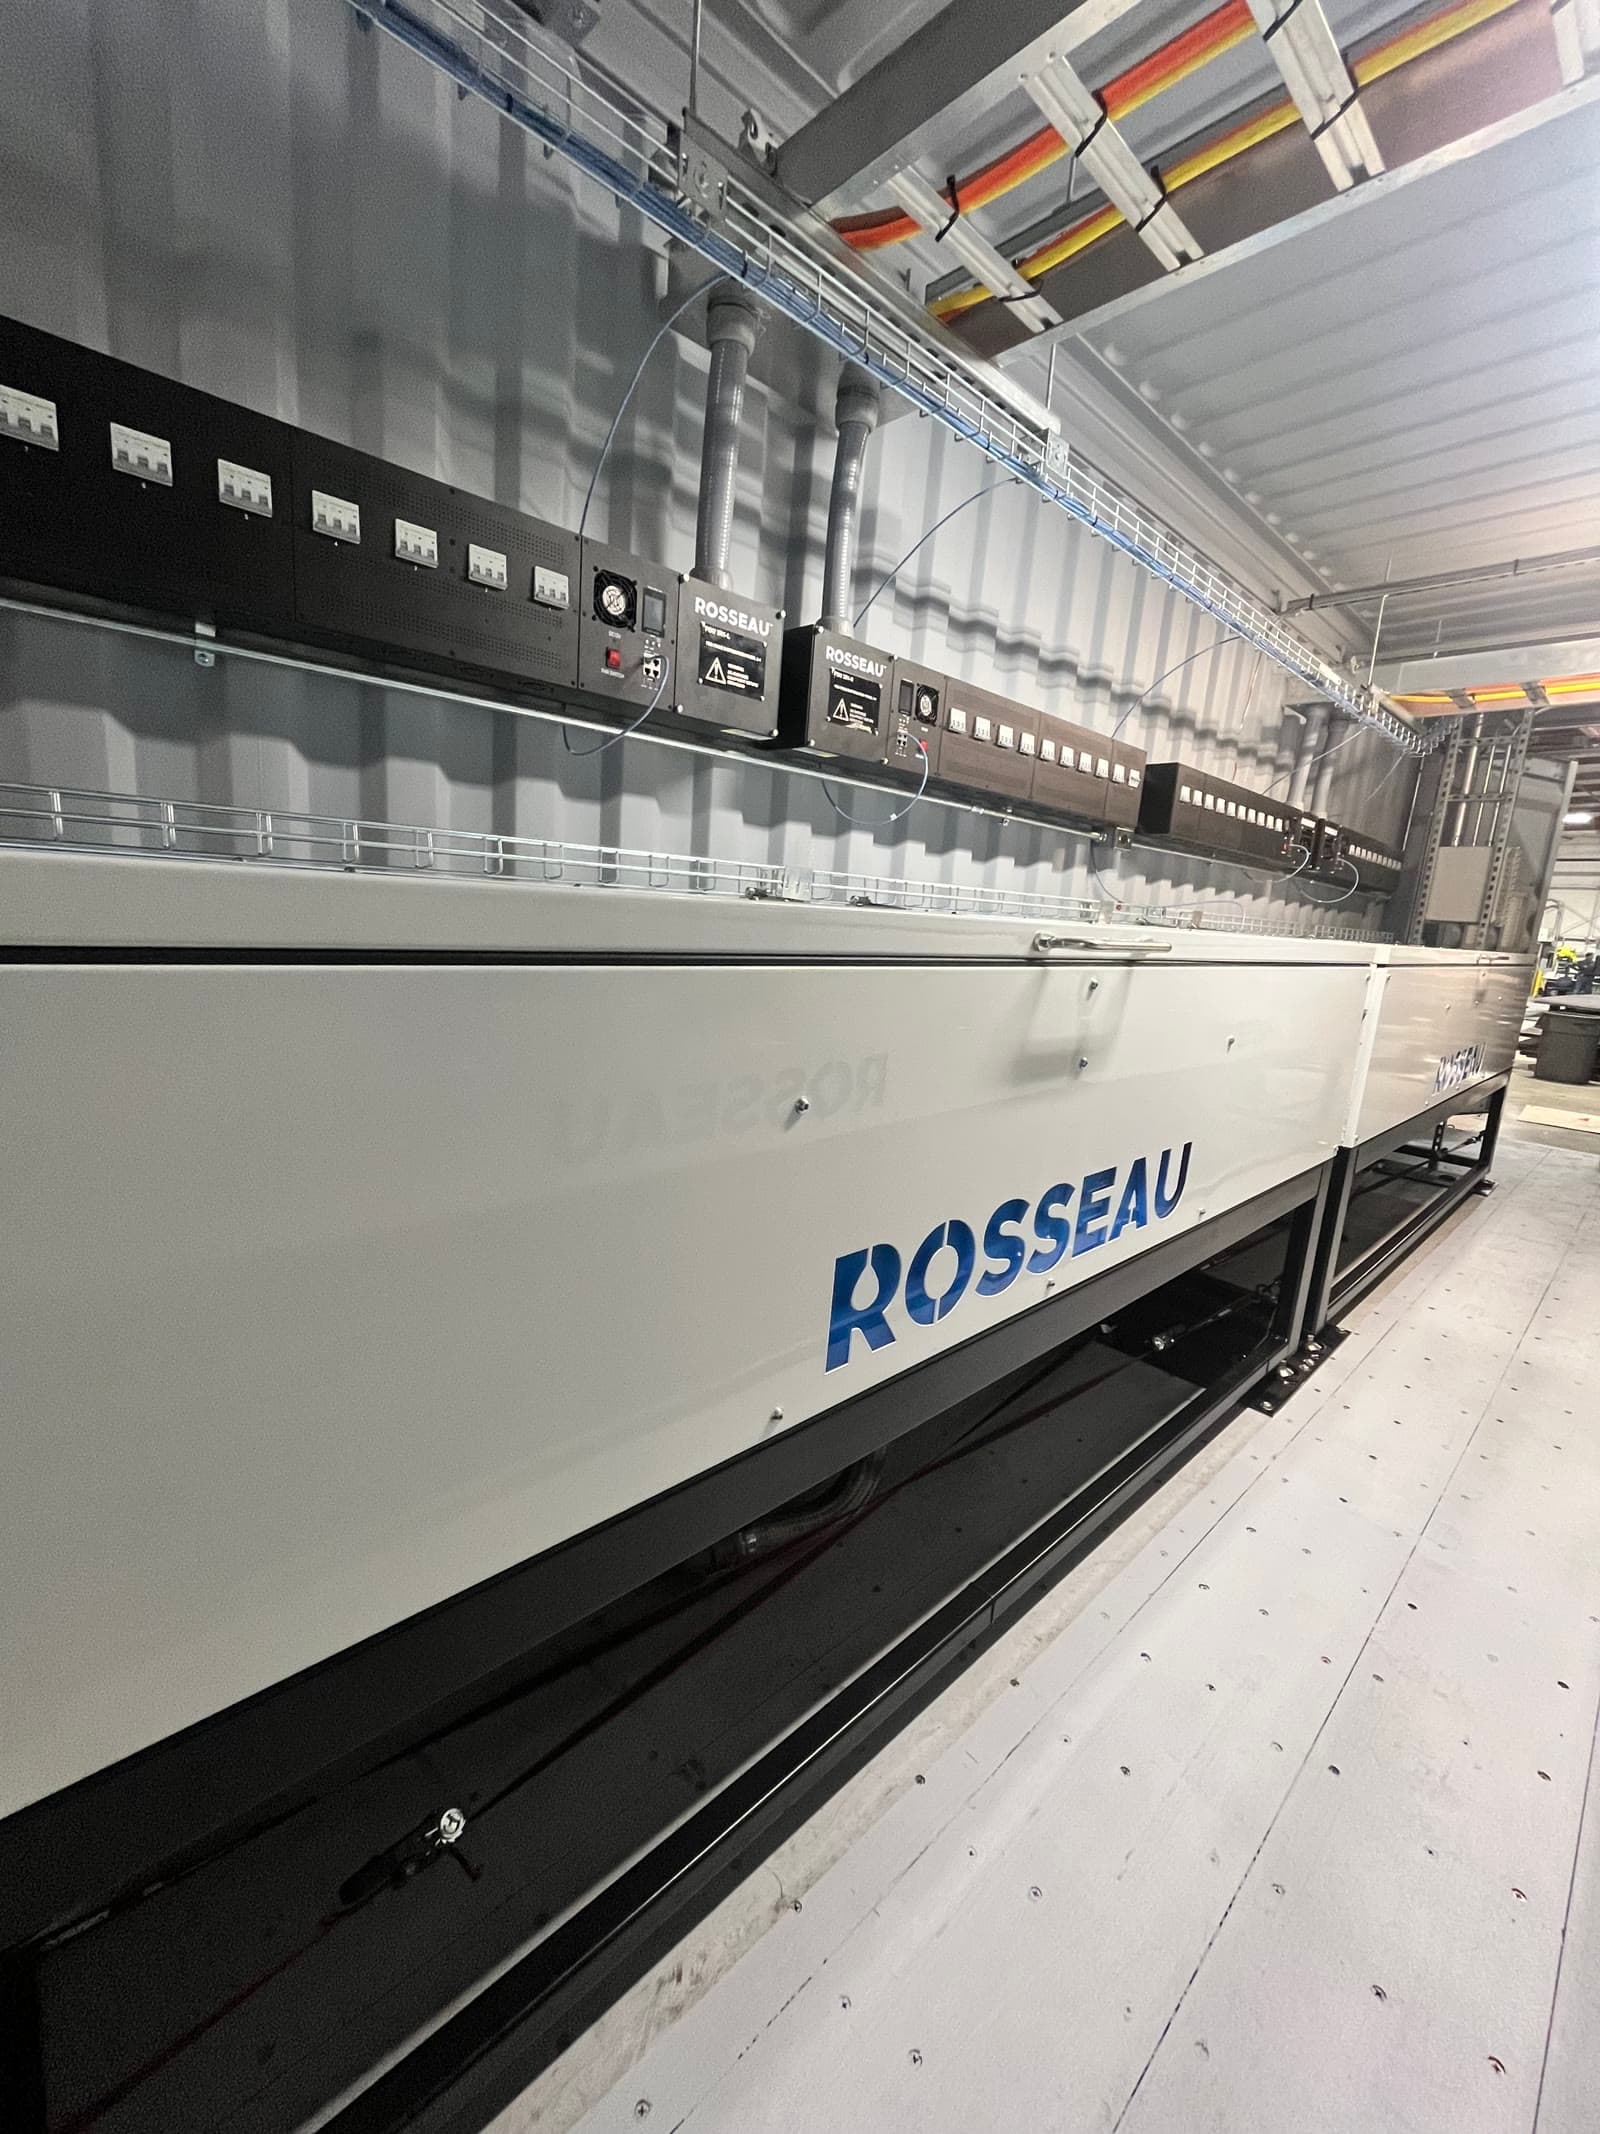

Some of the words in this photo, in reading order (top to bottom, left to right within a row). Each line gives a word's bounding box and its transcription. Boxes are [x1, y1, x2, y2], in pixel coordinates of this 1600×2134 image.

[694, 596, 770, 637] ROSSEAU
[825, 645, 884, 678] ROSSEAU
[824, 1141, 1194, 1376] ROSSEAU
